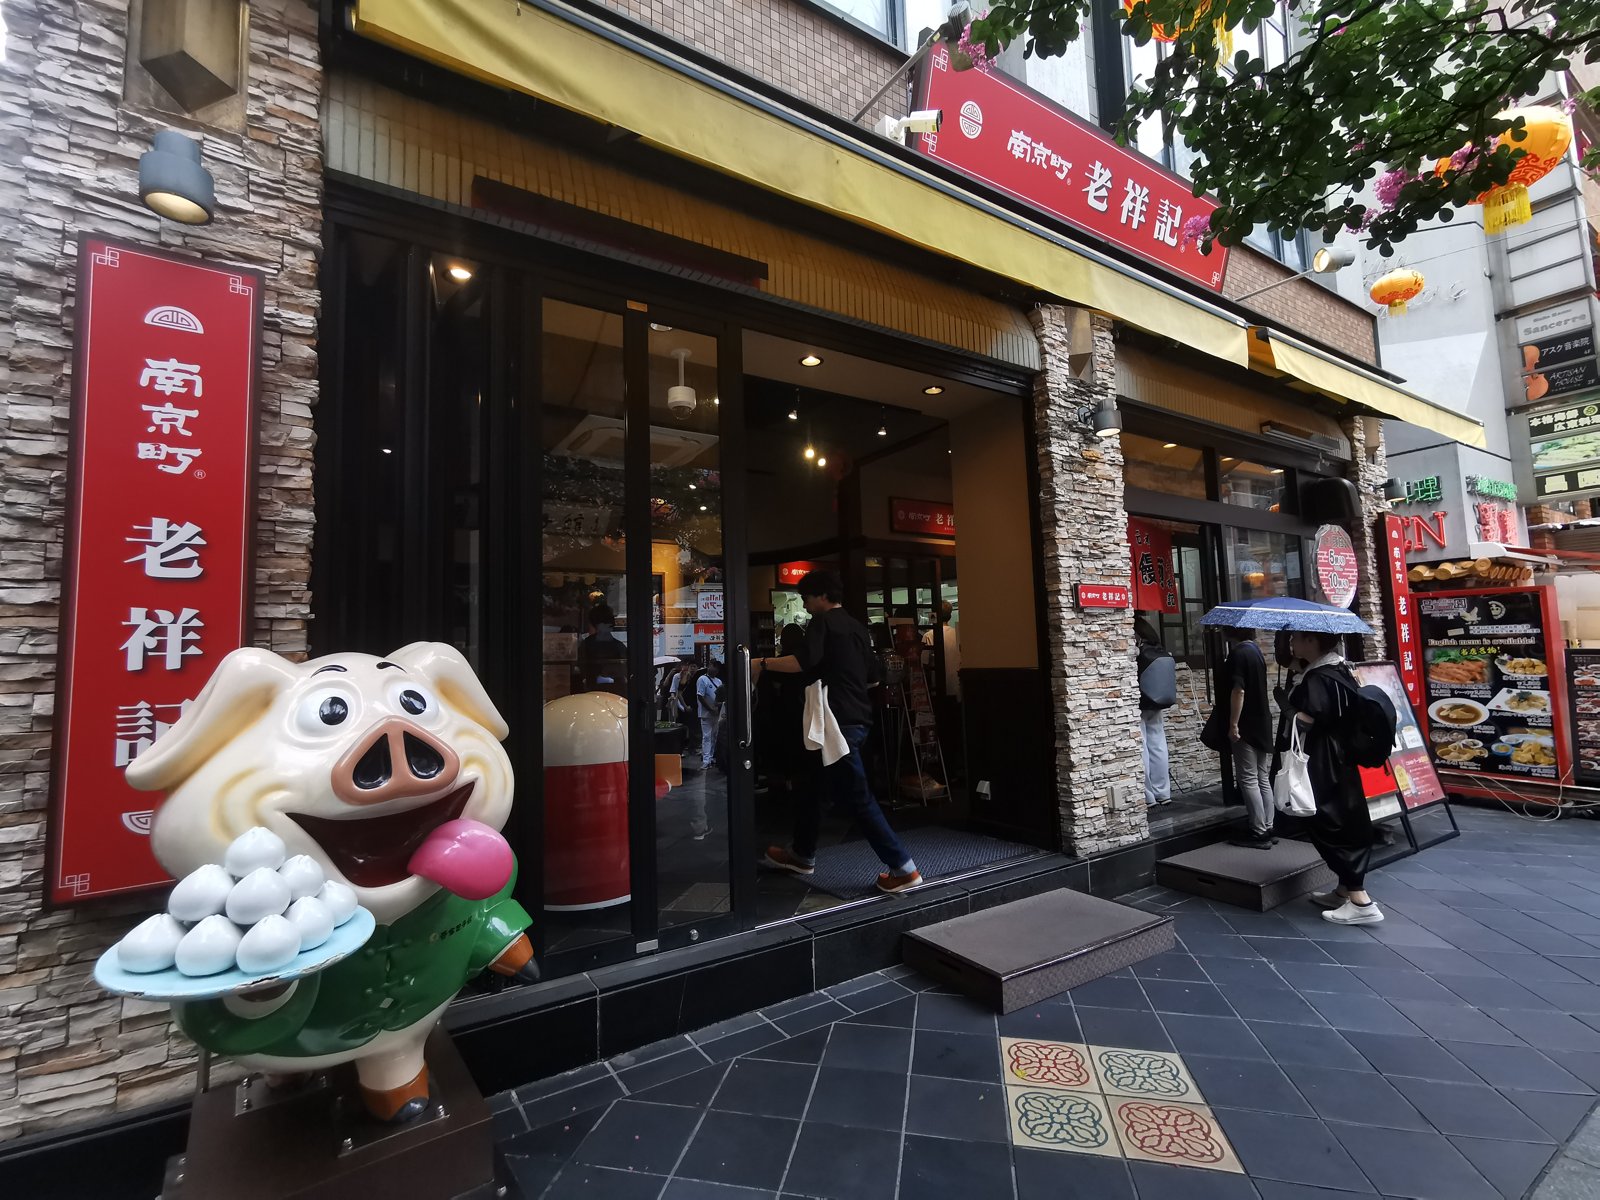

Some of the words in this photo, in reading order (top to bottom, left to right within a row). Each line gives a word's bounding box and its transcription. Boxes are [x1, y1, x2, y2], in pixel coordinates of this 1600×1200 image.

[1081, 159, 1183, 248] 老祥記
[1523, 313, 1587, 336] Sancerre
[1550, 366, 1587, 380] ARTISAN
[1398, 595, 1413, 671] 老祥記
[1428, 638, 1458, 646] English
[1492, 637, 1536, 645] available!
